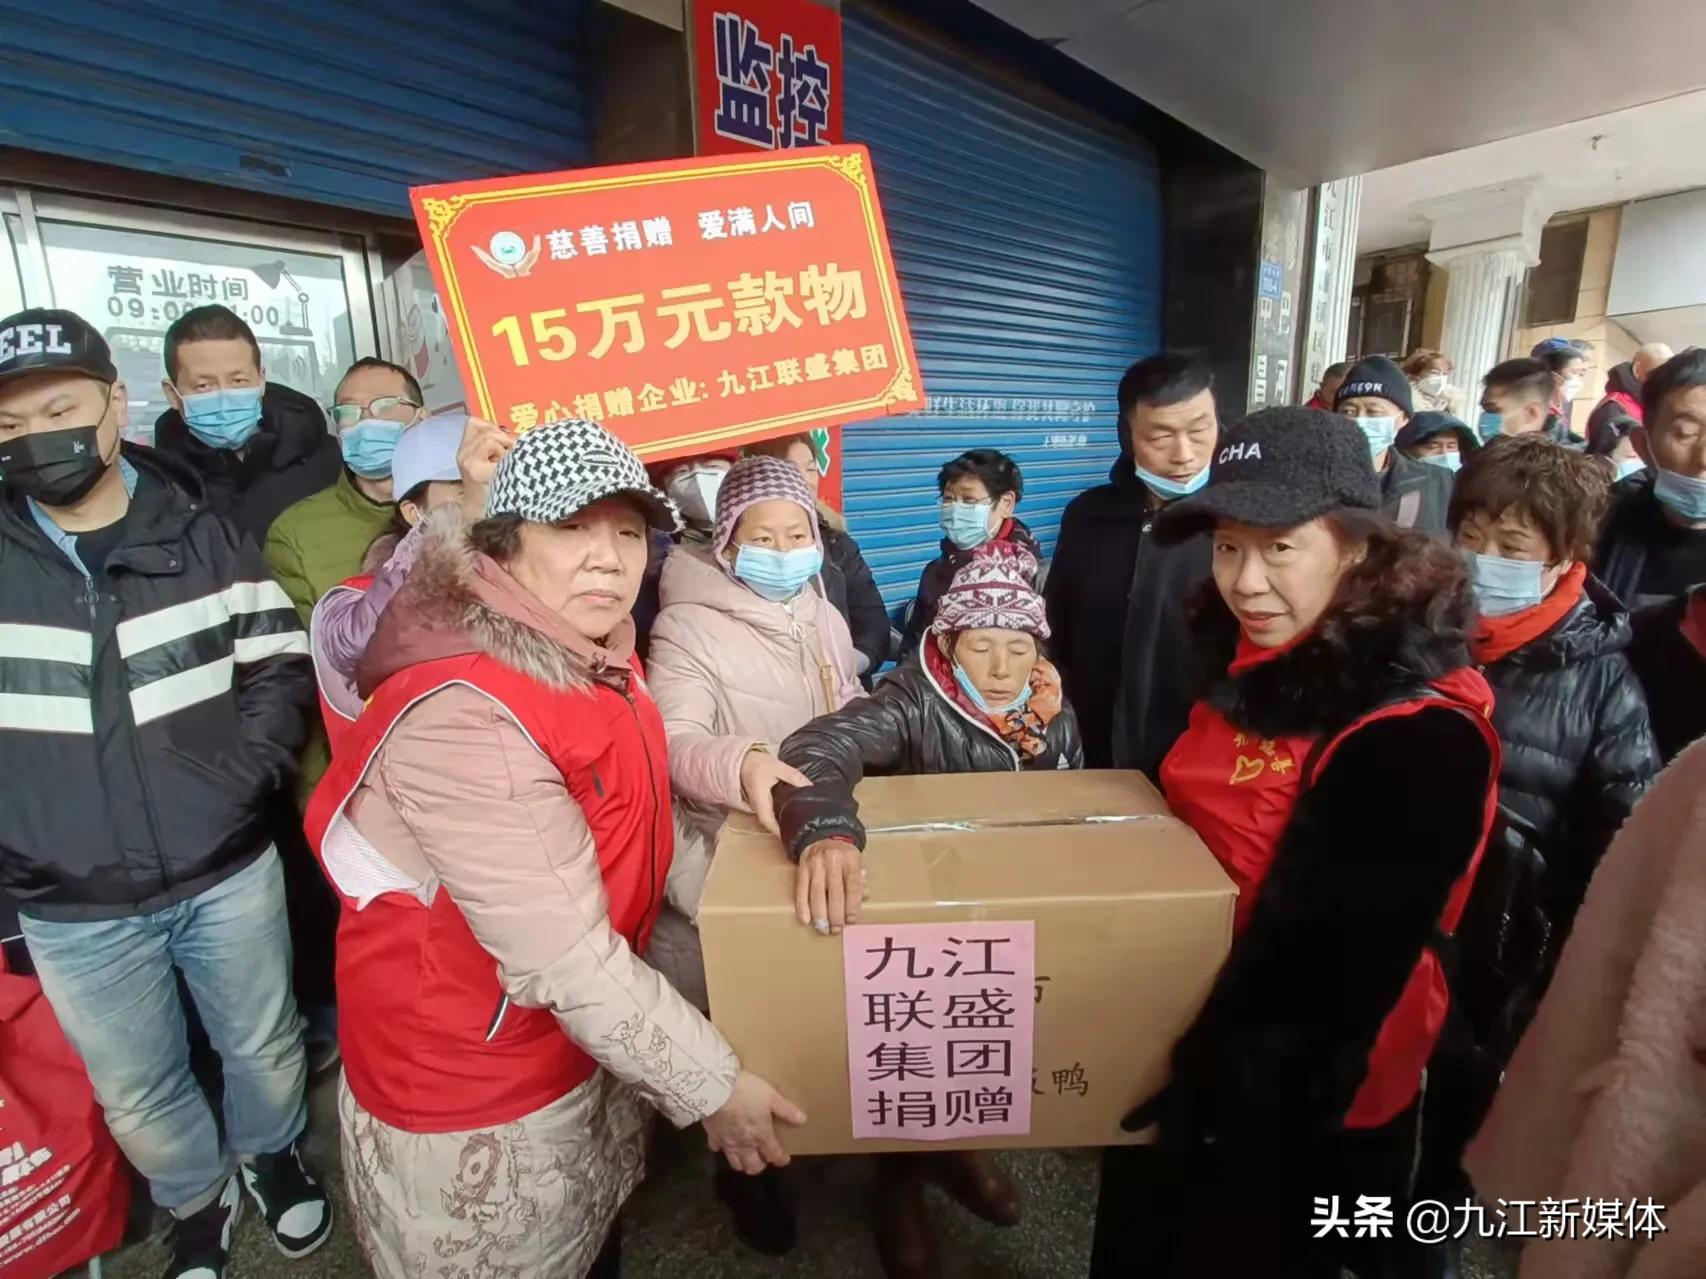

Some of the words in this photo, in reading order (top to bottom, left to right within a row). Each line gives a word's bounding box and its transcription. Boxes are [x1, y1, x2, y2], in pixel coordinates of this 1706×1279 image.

[713, 11, 832, 149] 监控
[545, 216, 674, 261] 慈善捐赠
[697, 200, 816, 241] 爱满人间
[107, 264, 249, 300] 营业时间
[491, 262, 869, 367] 15万元款物
[1218, 442, 1262, 464] CHA
[864, 936, 1016, 981] 九江
[862, 987, 1016, 1033] 联盛
[865, 1039, 1012, 1082] 集团
[867, 1085, 1013, 1129] 捐赠
